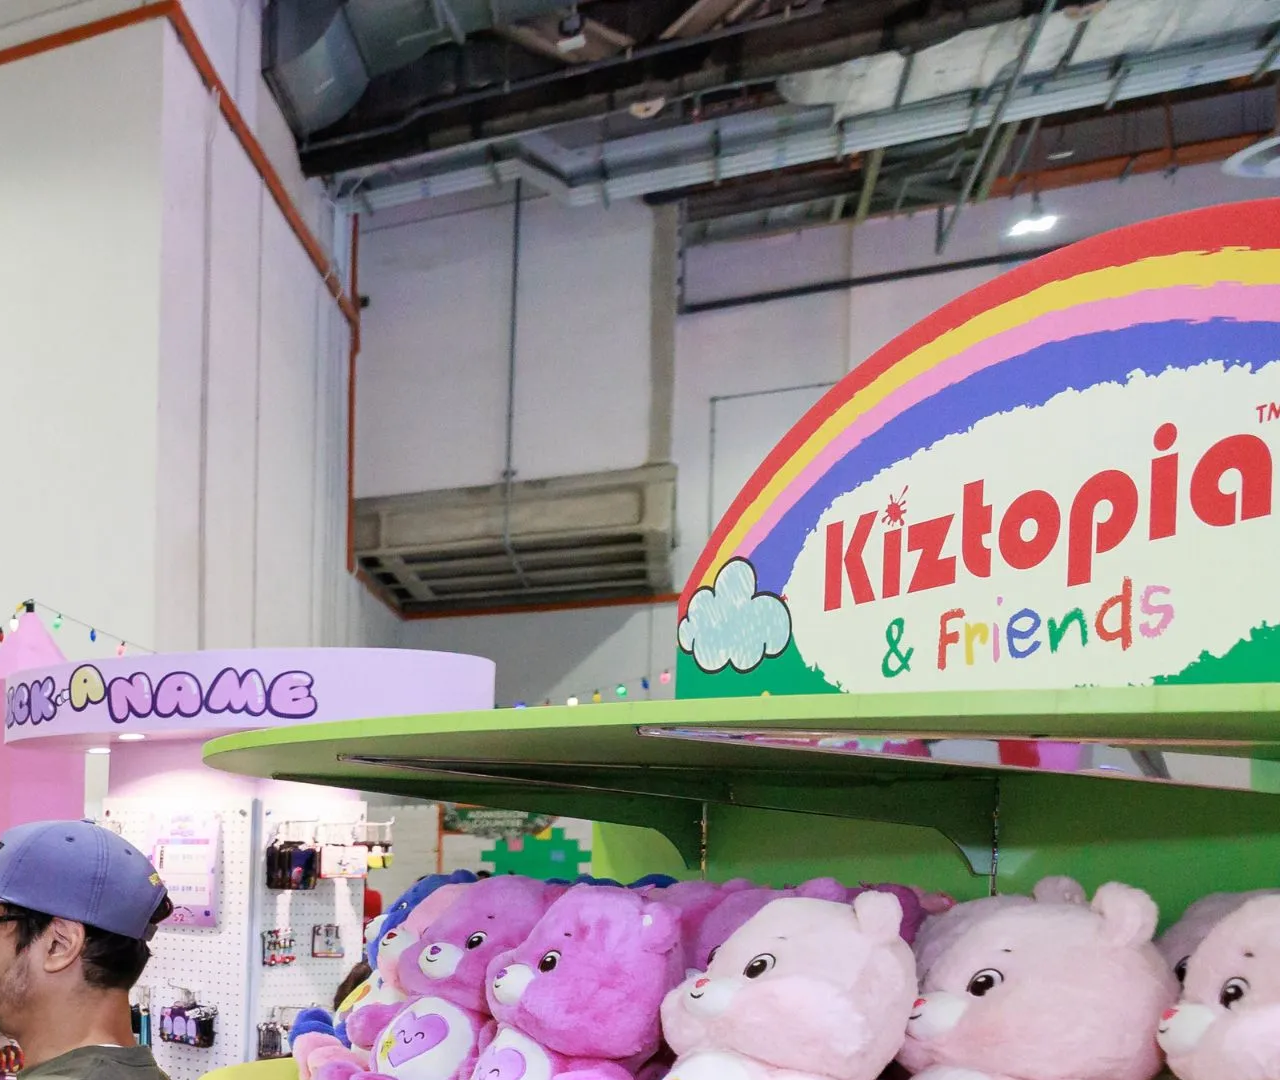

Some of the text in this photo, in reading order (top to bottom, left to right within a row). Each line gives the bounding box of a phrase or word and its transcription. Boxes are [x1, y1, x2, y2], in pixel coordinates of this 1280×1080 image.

[824, 423, 1272, 611] Kiztopia
[881, 576, 1175, 678] & Friends
[69, 664, 105, 712] A
[107, 667, 318, 724] NAME
